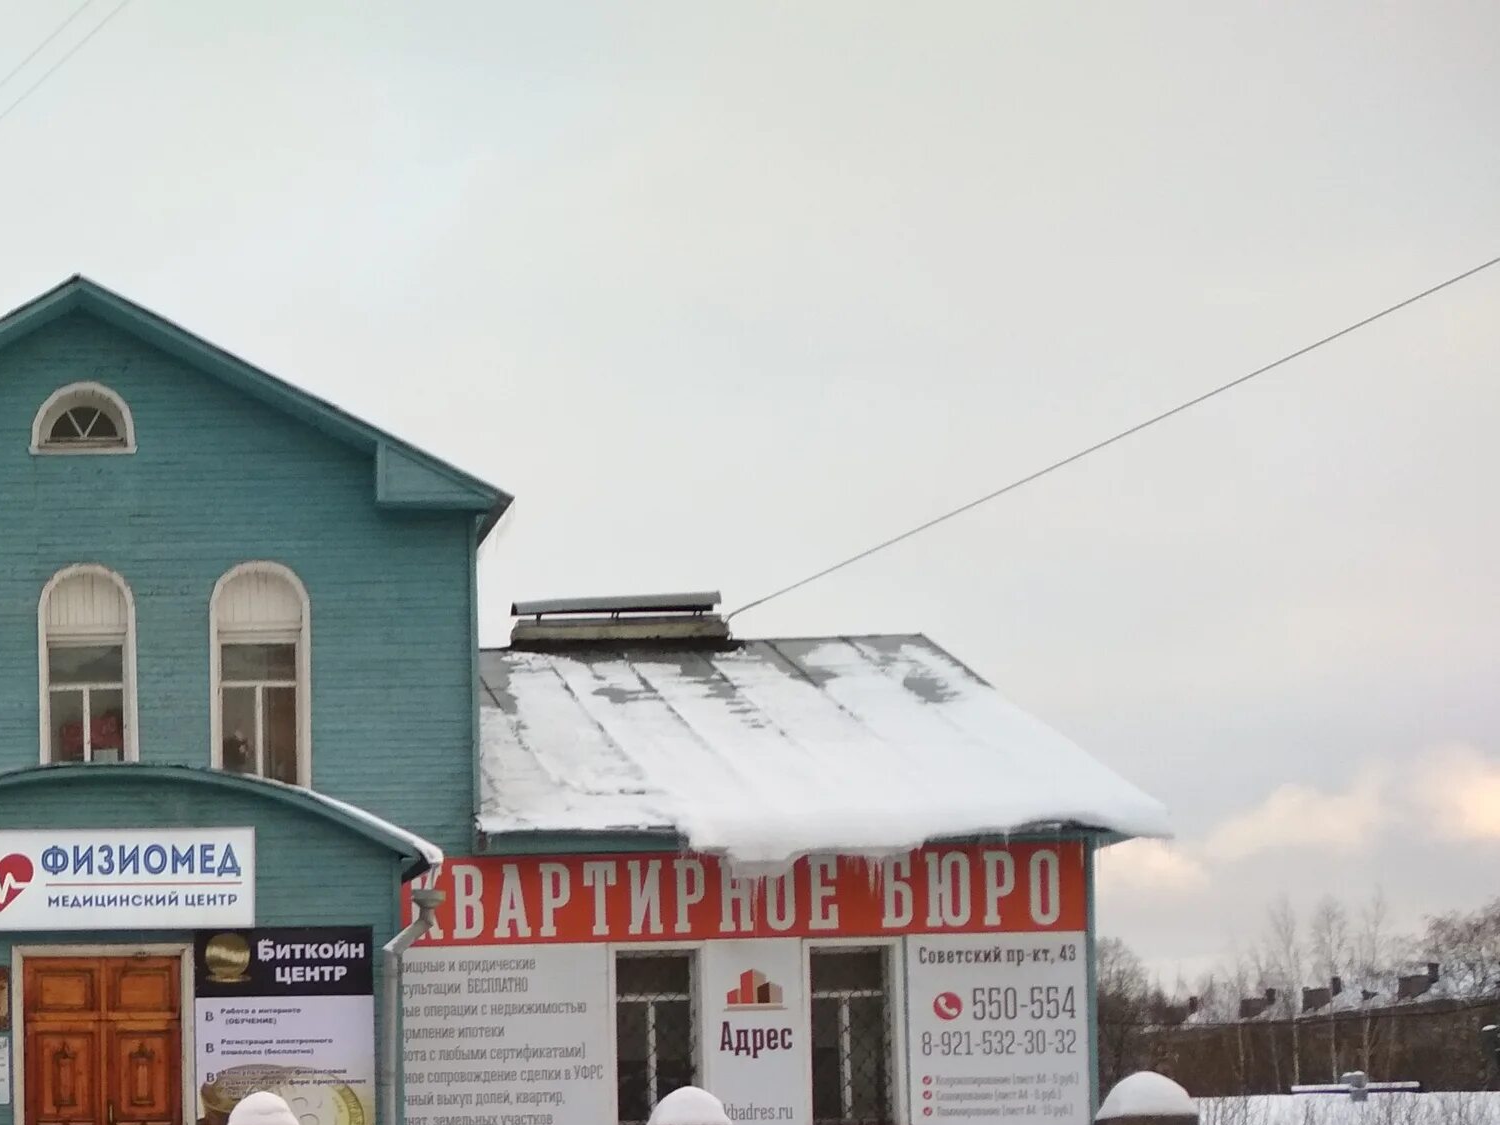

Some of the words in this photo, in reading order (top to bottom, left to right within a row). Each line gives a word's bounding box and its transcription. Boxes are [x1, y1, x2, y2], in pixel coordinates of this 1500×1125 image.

[41, 842, 241, 877] ФИЗИОМЕД
[48, 891, 179, 908] МЕДИЦИНСКИЙ
[184, 892, 238, 908] ЦЕНТР
[881, 848, 1061, 930] БЮРО
[448, 960, 456, 972] и
[458, 957, 536, 975] юридические
[918, 946, 1002, 965] Советский
[1006, 947, 1056, 967] пр-кт,
[1059, 944, 1077, 962] 43
[275, 966, 348, 985] ЦЕНТР
[403, 981, 461, 998] сультации
[467, 977, 529, 993] БЕСПЛАТНО
[424, 1003, 478, 1020] операции
[481, 1004, 488, 1015] с
[490, 1001, 587, 1018] недвижимостью
[972, 986, 1077, 1021] 550-554
[458, 1025, 506, 1039] ипотеки
[720, 1021, 794, 1059] Адрес
[921, 1029, 1077, 1057] 8-921-532-30-32
[429, 1050, 436, 1062] с
[438, 1046, 488, 1061] любыми
[427, 1068, 518, 1086] сопровождение
[520, 1067, 562, 1082] сделки
[564, 1069, 571, 1080] в
[573, 1064, 604, 1081] УФРС
[437, 1093, 474, 1109] выкуп
[476, 1090, 513, 1107] долей,
[516, 1091, 566, 1108] квартир,
